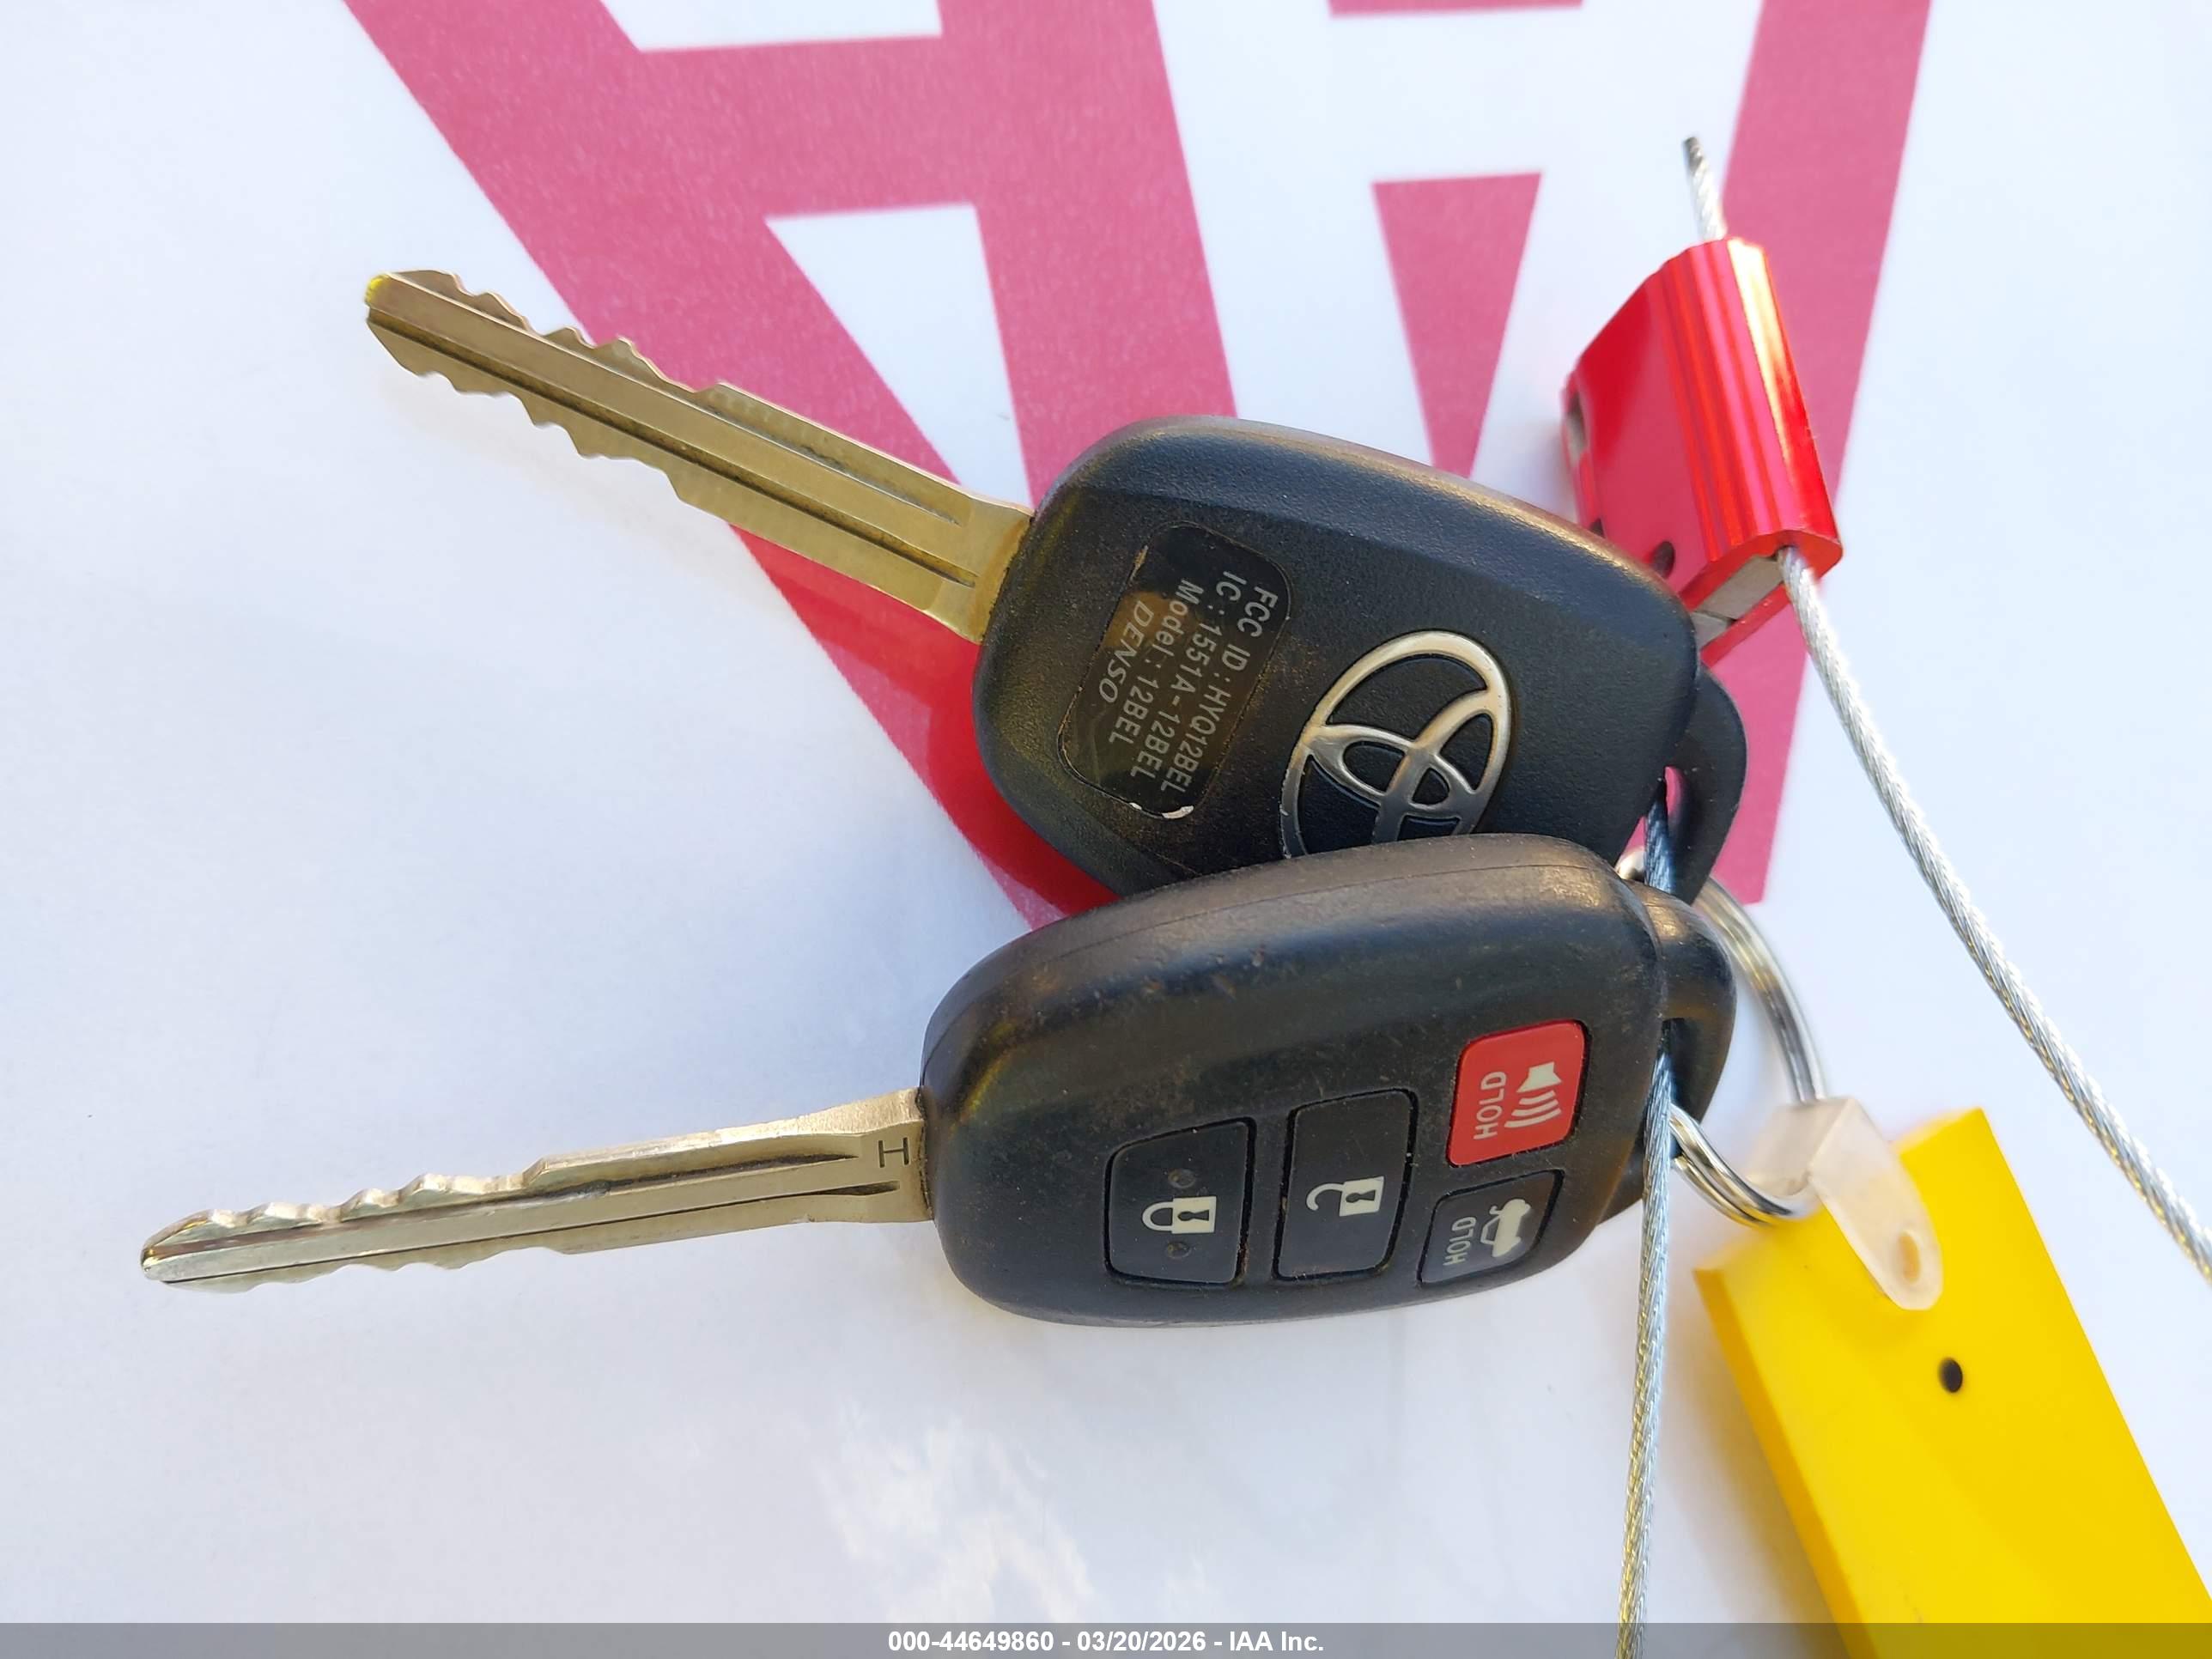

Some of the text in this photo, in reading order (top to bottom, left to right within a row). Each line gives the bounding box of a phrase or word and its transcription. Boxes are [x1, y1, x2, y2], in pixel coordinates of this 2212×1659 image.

[1237, 586, 1279, 638] FCC
[1098, 600, 1155, 703] DENSO
[1108, 676, 1159, 744] 12BEL
[1130, 623, 1223, 780] 1551A-12BEL
[1473, 1070, 1507, 1140] HOLD
[878, 1136, 910, 1169] H
[1443, 1215, 1477, 1267] HOLD
